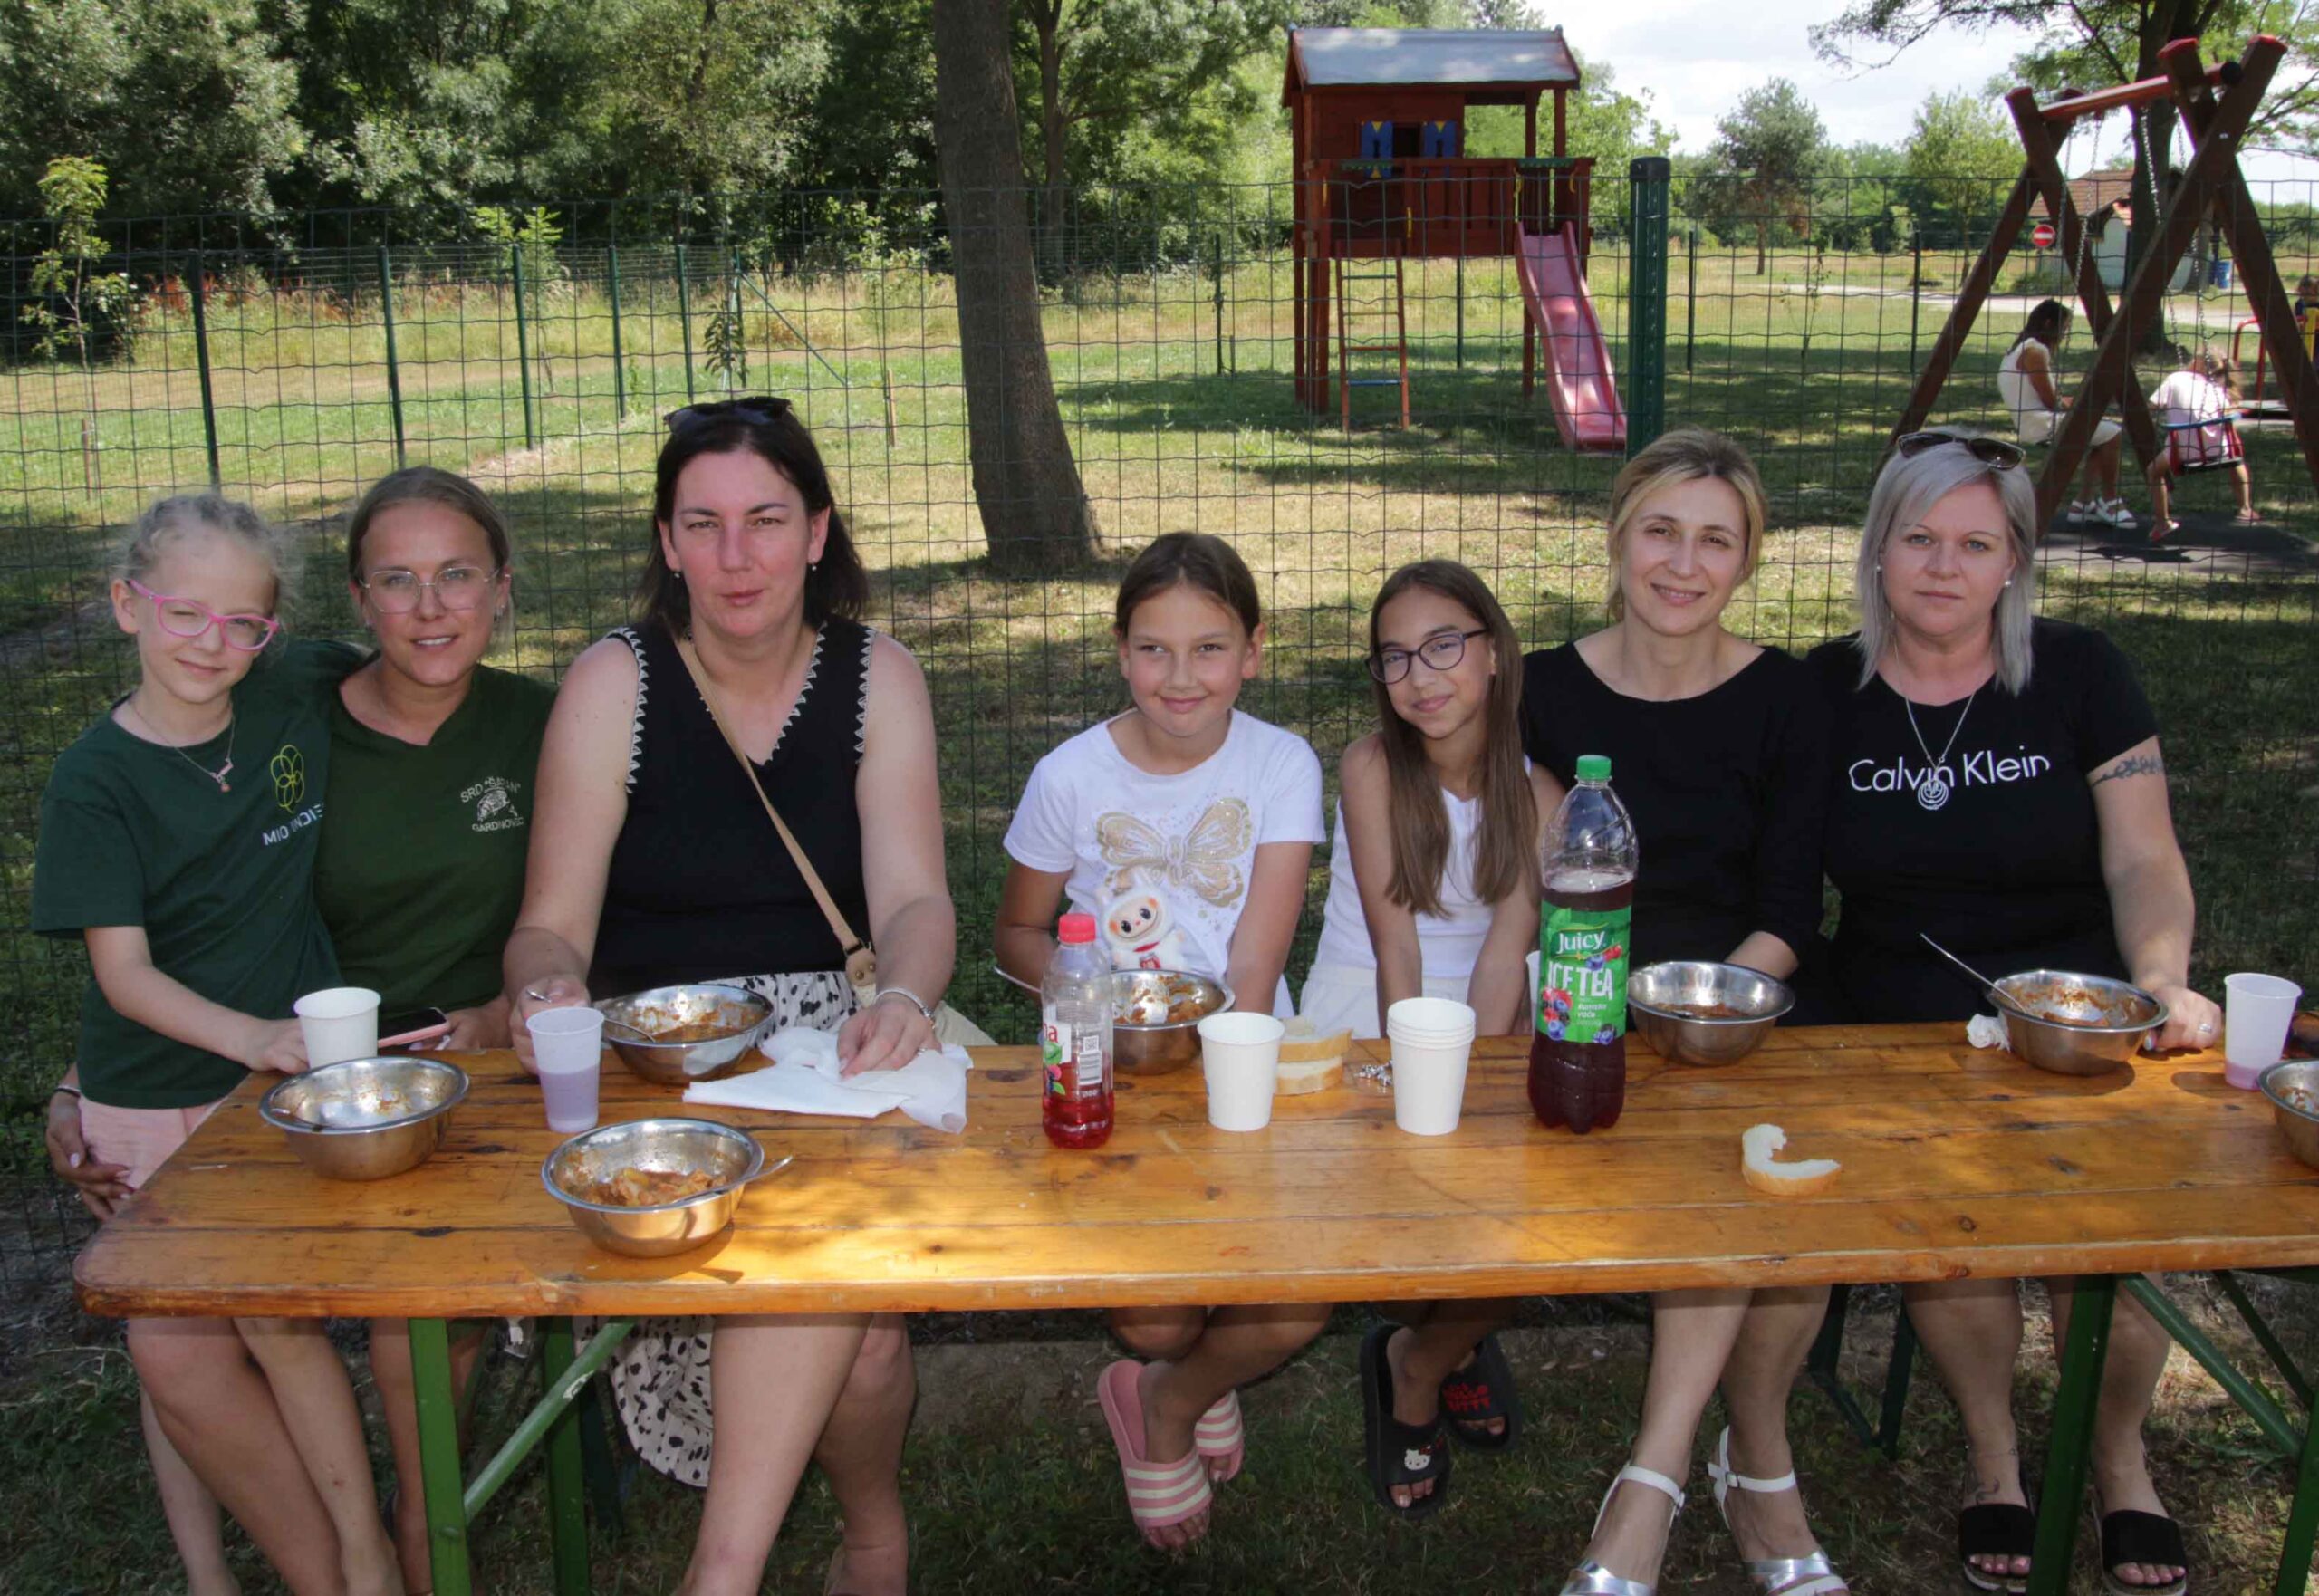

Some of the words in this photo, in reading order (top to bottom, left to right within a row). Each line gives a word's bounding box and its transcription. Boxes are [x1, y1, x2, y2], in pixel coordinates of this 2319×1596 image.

[1849, 755, 1955, 792] Calvin
[1962, 745, 2050, 786] Klein
[460, 783, 484, 803] SRD
[262, 825, 289, 845] MIO
[1556, 931, 1606, 954] Juicy
[1547, 960, 1573, 992] ICE
[1576, 966, 1613, 1000] TEA
